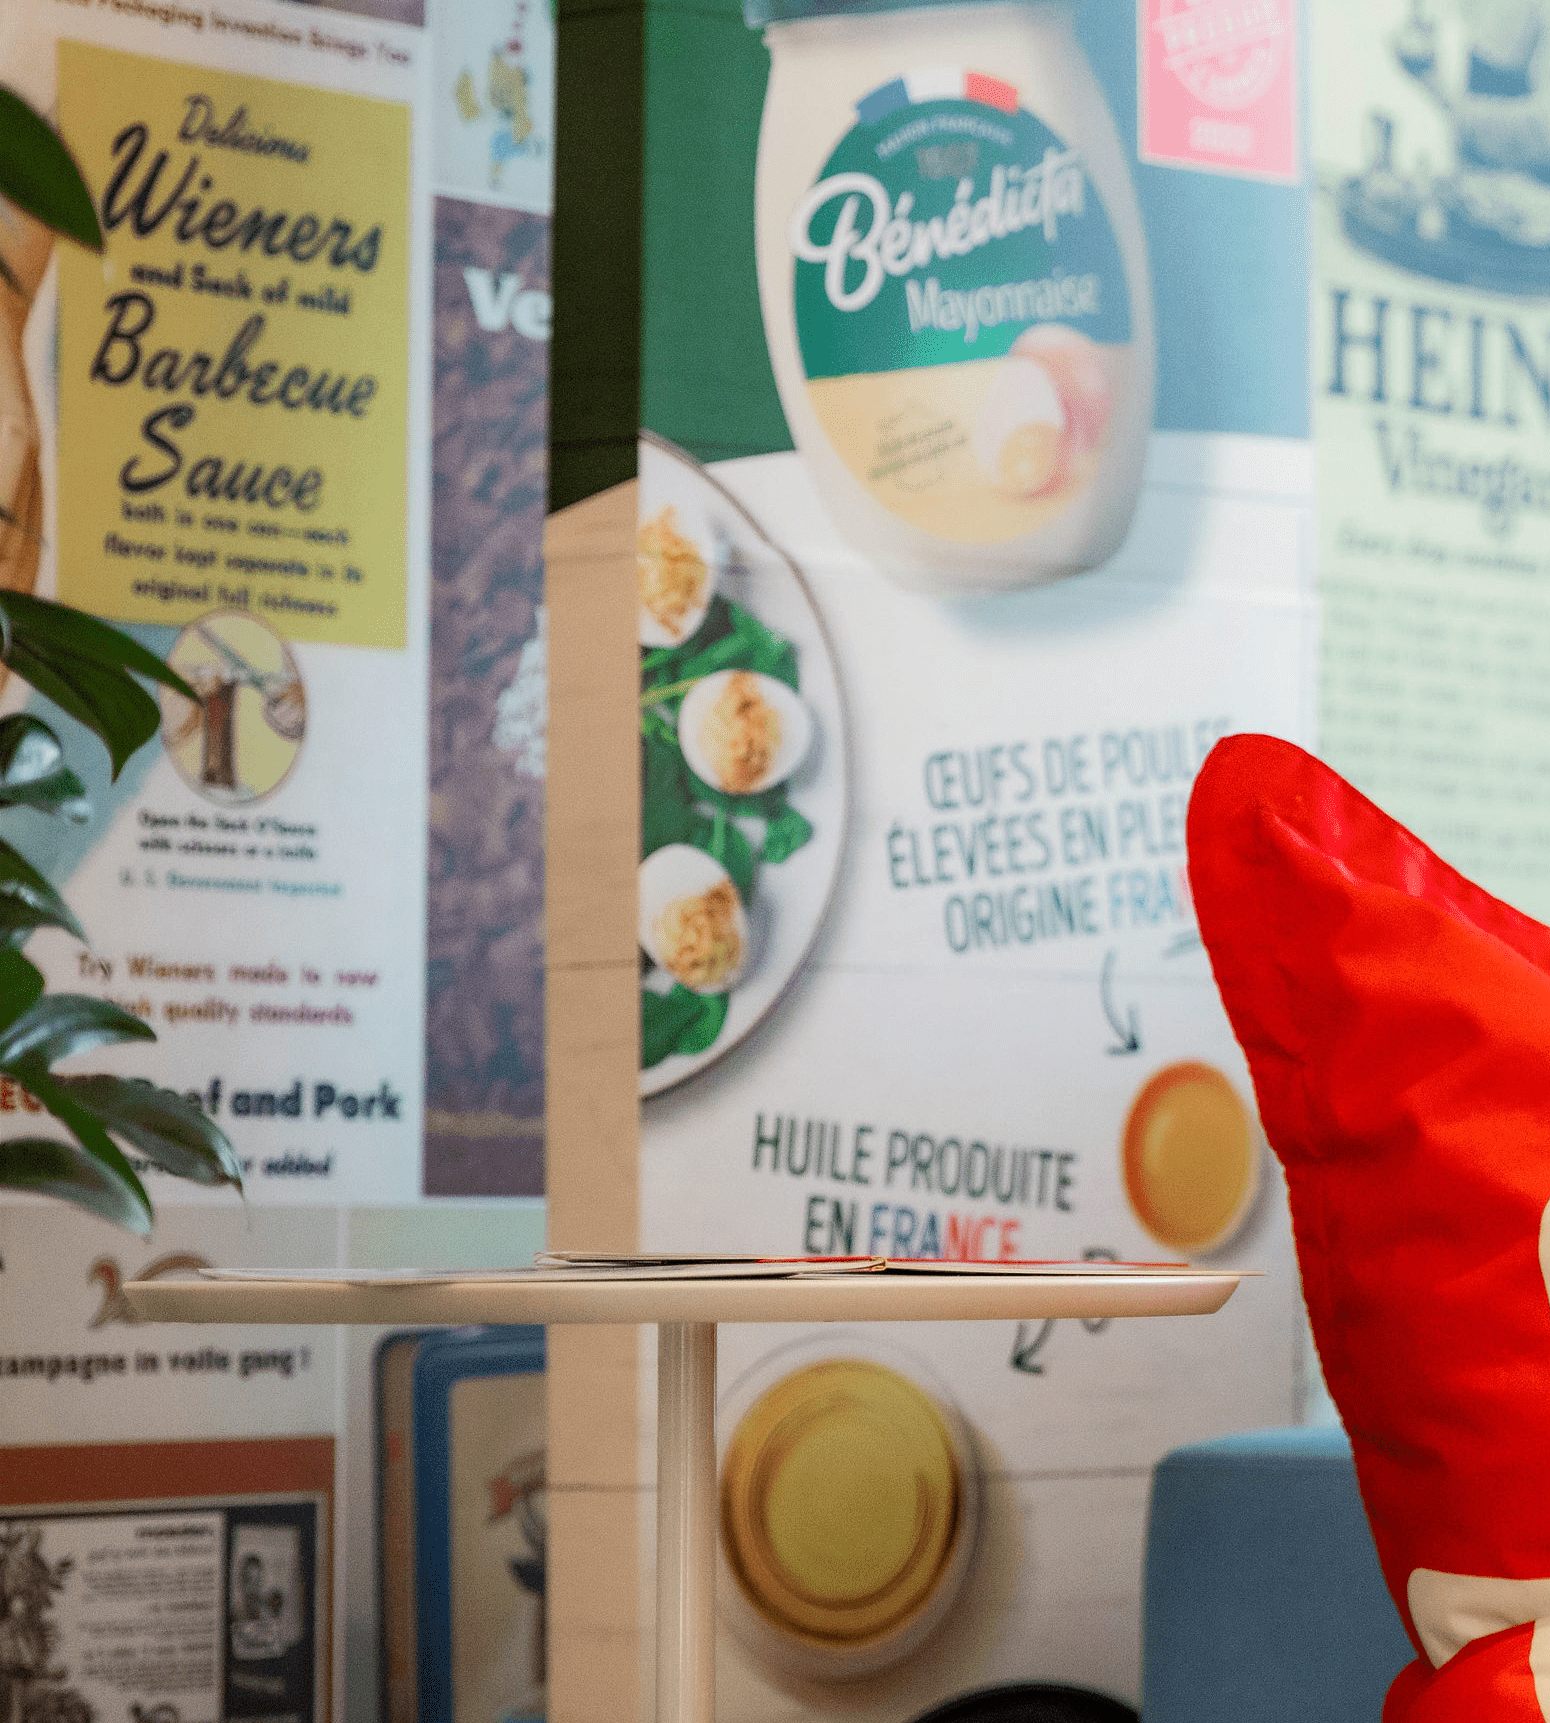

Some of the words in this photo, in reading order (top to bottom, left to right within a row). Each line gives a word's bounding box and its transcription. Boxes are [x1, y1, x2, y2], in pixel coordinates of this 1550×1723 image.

[179, 94, 310, 163] Delicious
[102, 122, 384, 272] Wieners
[789, 145, 1093, 312] Bénédicta
[130, 263, 183, 288] and
[262, 278, 289, 305] of
[297, 283, 351, 316] mild
[906, 267, 1097, 343] Mayonnaise
[91, 290, 378, 418] Barbecue
[119, 402, 324, 513] Sauce
[122, 500, 165, 522] both
[175, 509, 194, 527] in
[104, 532, 166, 560] flavor
[174, 544, 218, 568] kept
[131, 578, 209, 603] original
[217, 584, 250, 605] full
[1043, 735, 1091, 796] DE
[1100, 716, 1231, 790] POULE
[1060, 806, 1108, 866] EN
[945, 875, 1099, 954] ORIGINE
[129, 950, 216, 984] Wieners
[231, 1078, 303, 1118] and
[314, 1080, 402, 1120] Pork
[753, 1111, 873, 1187] HUILE
[884, 1129, 1080, 1214] PRODUITE
[804, 1195, 857, 1256] EN
[866, 1203, 1021, 1262] FRANCE
[135, 1351, 159, 1377] in
